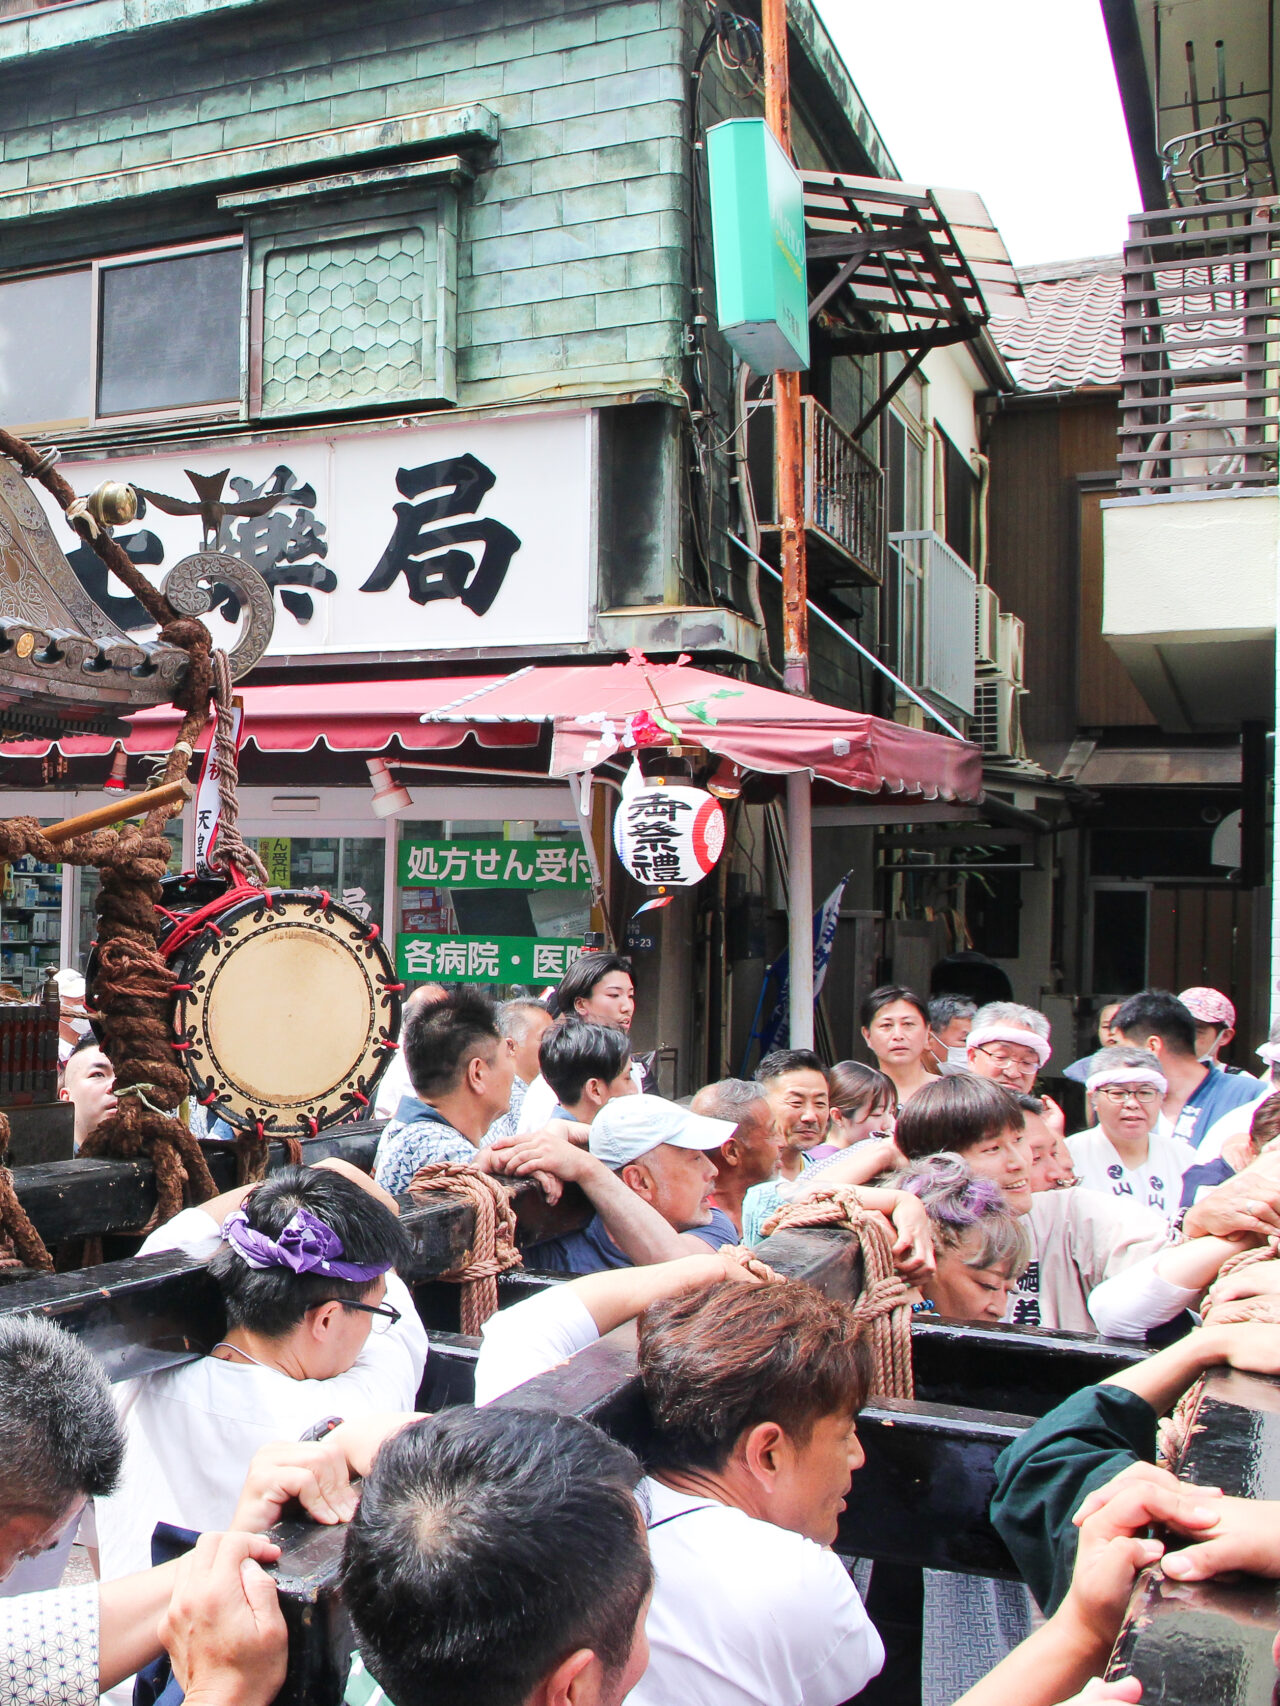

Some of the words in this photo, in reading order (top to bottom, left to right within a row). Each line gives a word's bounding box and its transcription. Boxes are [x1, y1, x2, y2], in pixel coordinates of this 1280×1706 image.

[407, 846, 592, 883] 処方せん受付
[628, 938, 652, 948] 9-23
